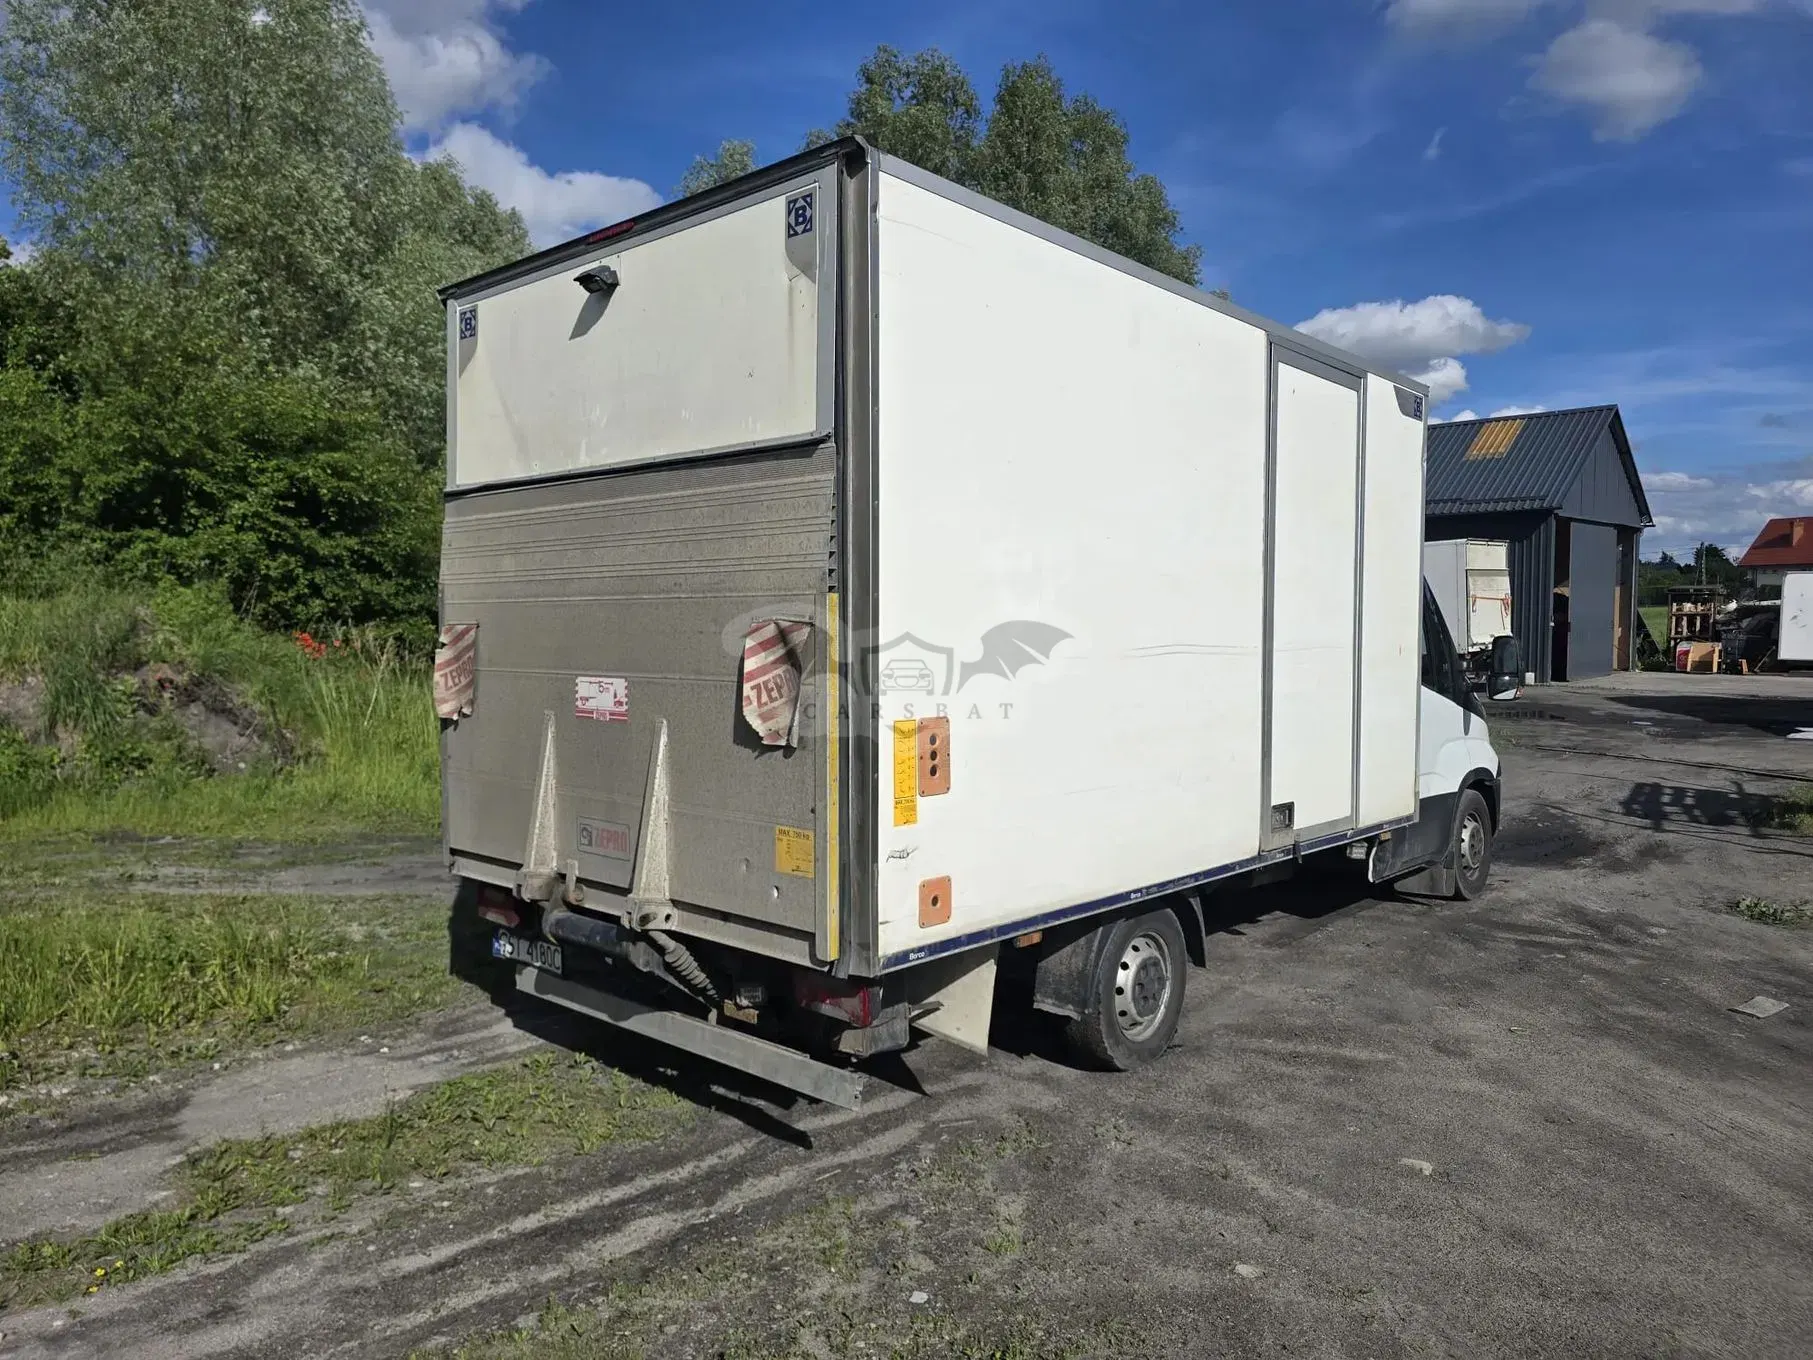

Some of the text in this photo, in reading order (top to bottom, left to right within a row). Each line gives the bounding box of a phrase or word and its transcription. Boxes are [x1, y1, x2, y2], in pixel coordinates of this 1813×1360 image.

[794, 204, 808, 227] B
[464, 317, 472, 331] B
[594, 827, 629, 852] ZEPRO
